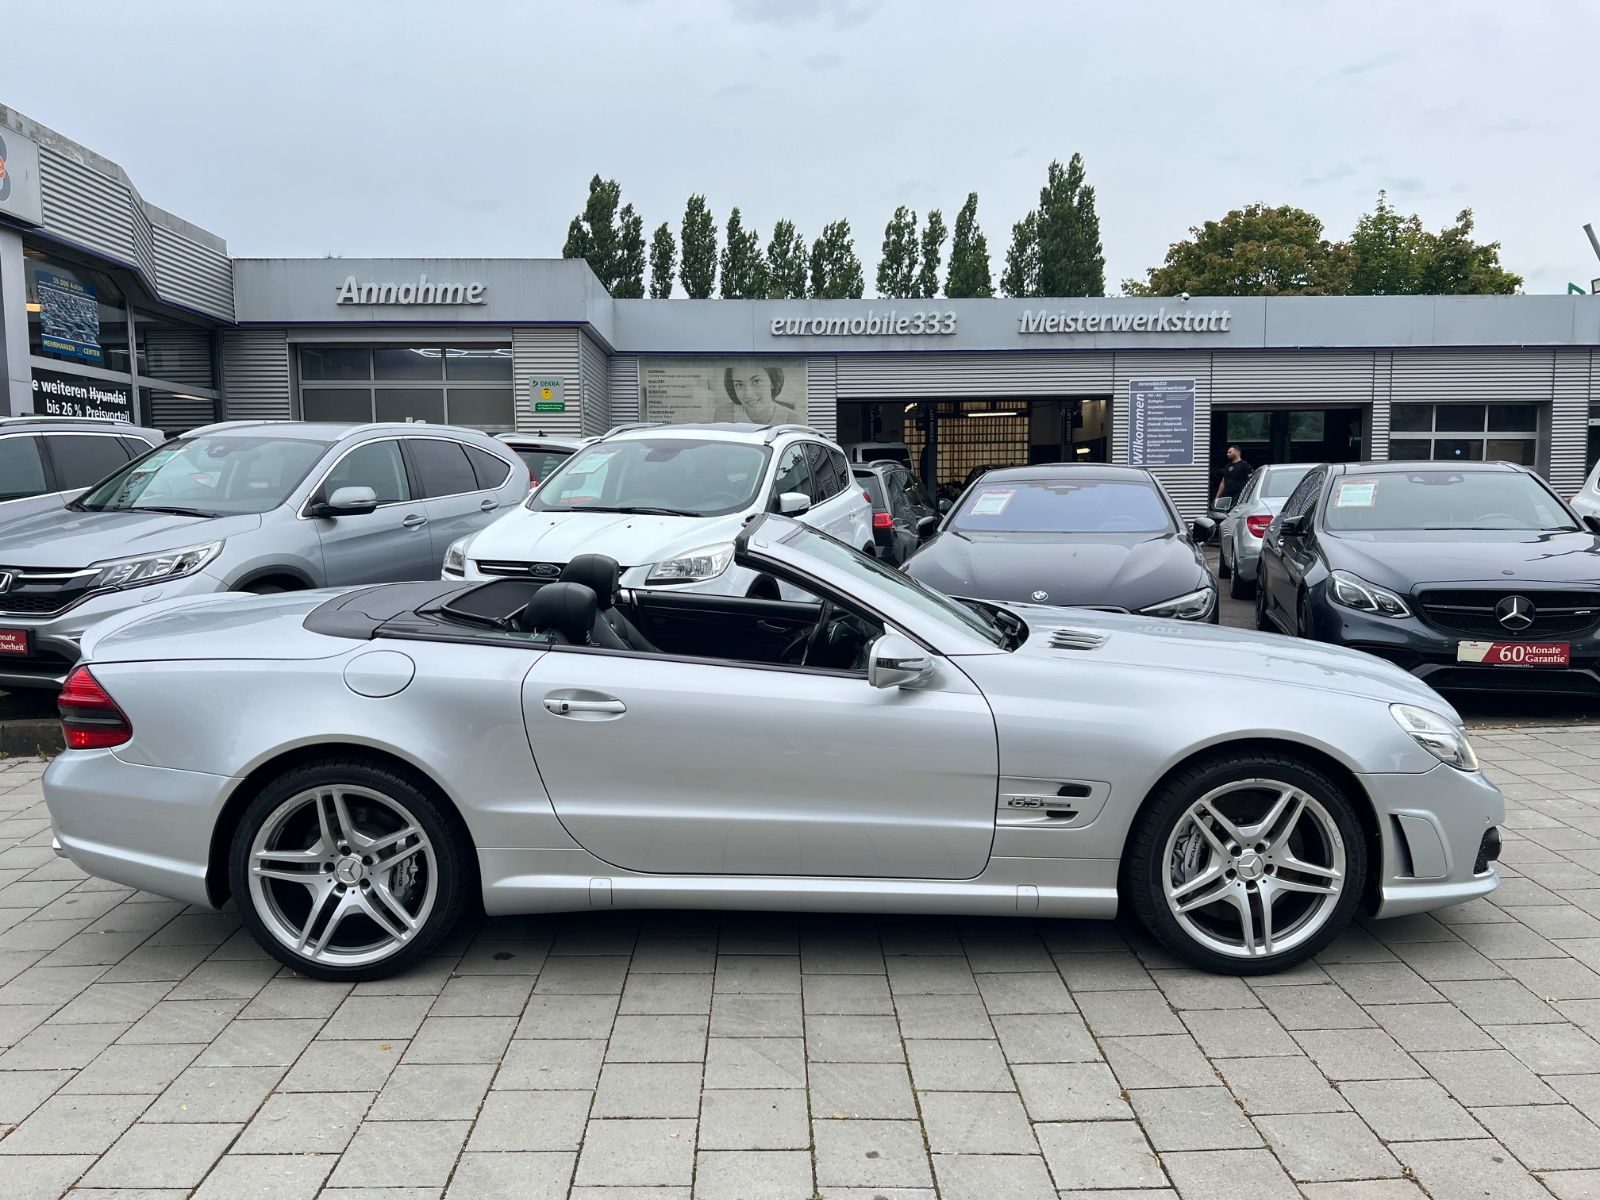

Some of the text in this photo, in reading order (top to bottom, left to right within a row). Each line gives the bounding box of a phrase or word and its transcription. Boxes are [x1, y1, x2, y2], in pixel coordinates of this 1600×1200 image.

[336, 274, 484, 304] Annahme
[770, 310, 957, 335] euromobile333
[1020, 307, 1232, 332] Meisterwerkstatt
[41, 379, 88, 399] weiteren
[89, 386, 127, 405] Hyundai
[46, 399, 60, 414] bis
[61, 401, 73, 416] 26
[1499, 645, 1561, 662] 60 Monate
